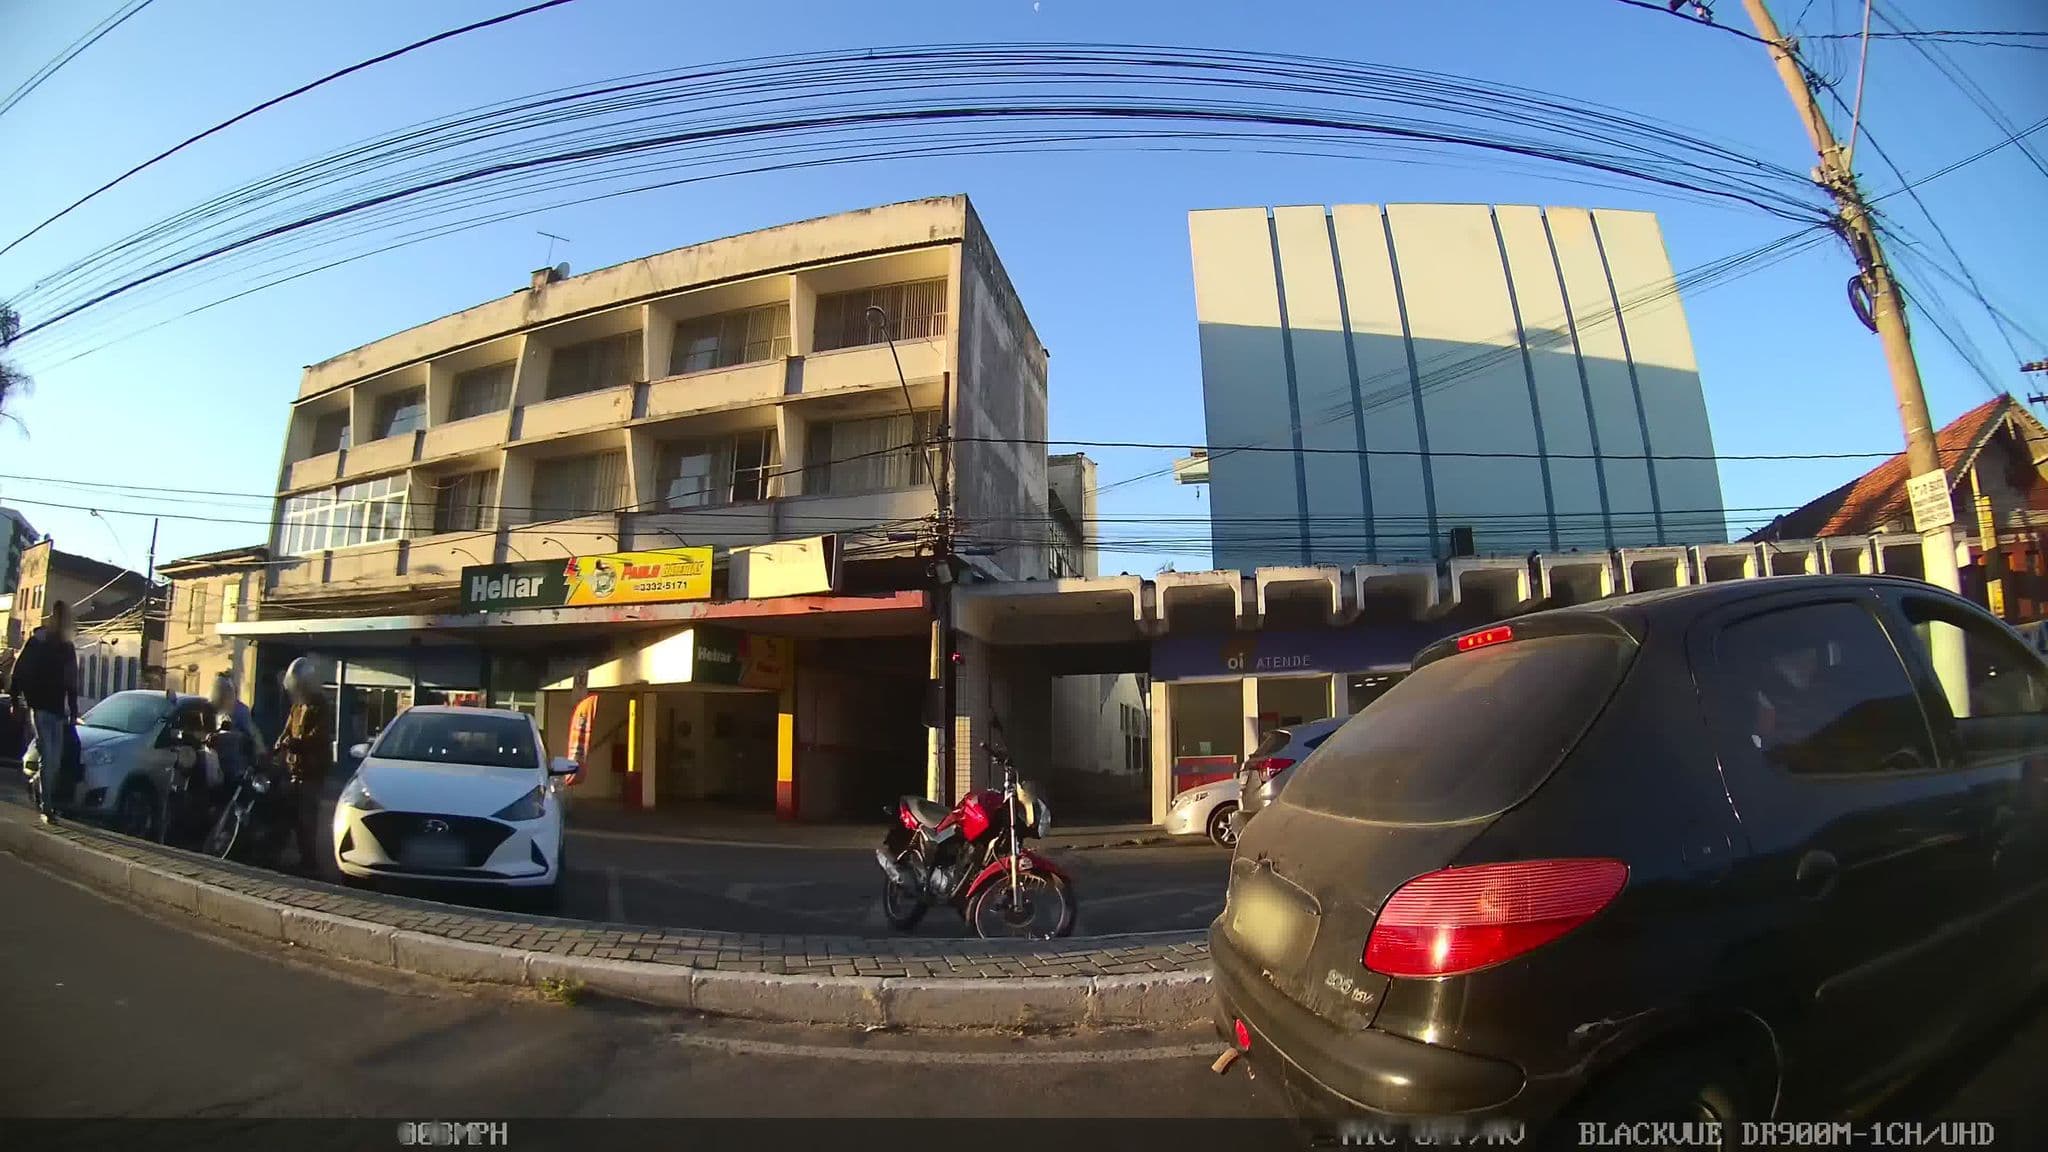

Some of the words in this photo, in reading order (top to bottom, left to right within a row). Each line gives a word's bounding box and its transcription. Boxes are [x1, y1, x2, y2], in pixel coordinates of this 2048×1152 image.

[470, 573, 544, 602] Heliar
[640, 581, 688, 592] 3332-5171
[1256, 655, 1312, 669] ATENDE
